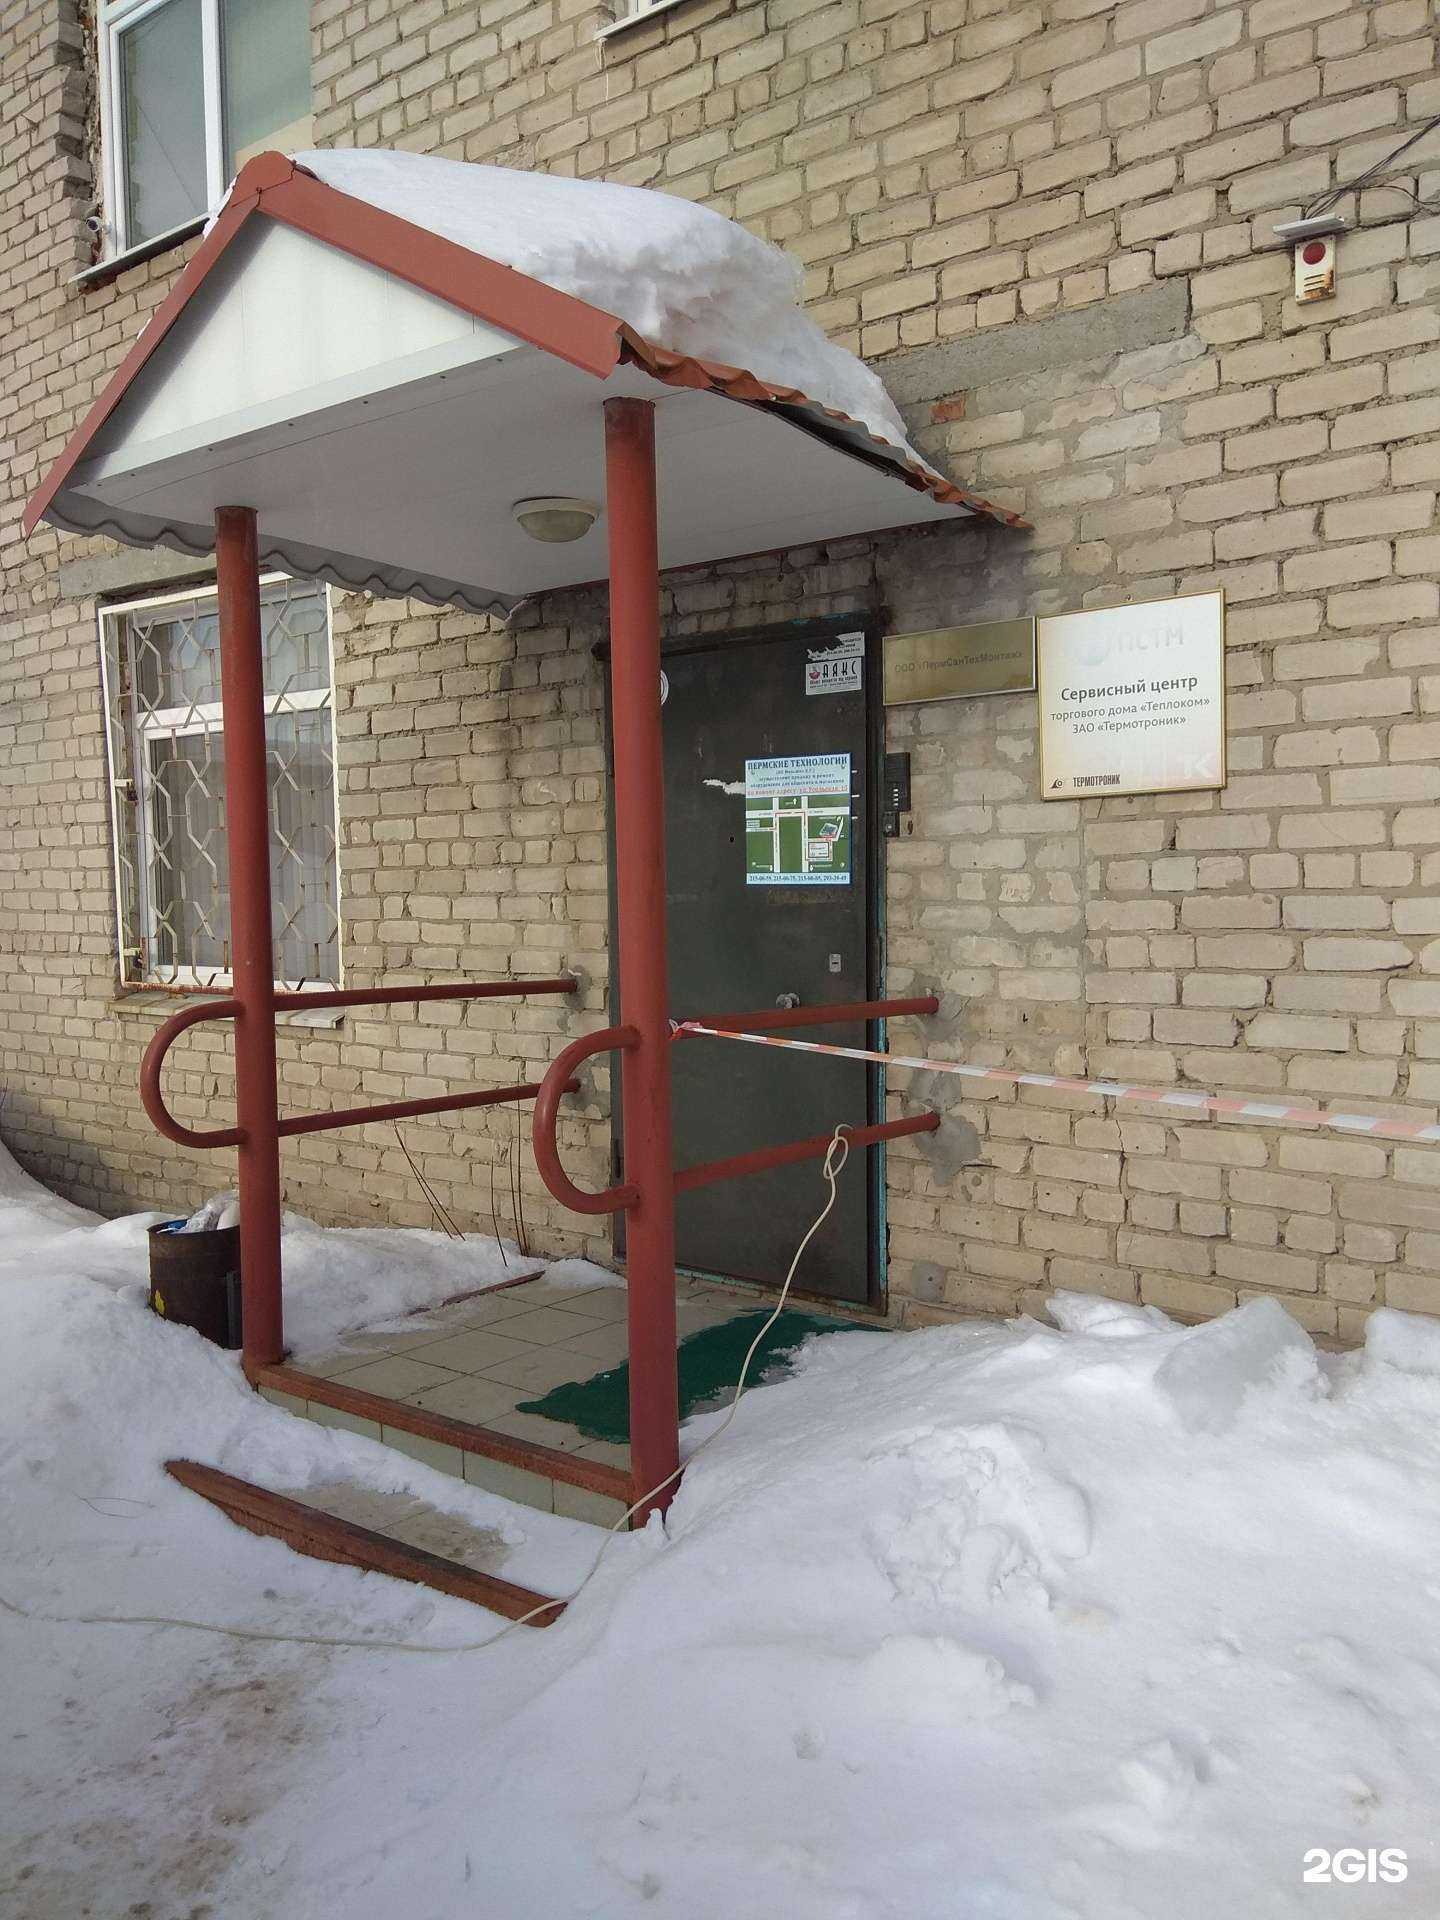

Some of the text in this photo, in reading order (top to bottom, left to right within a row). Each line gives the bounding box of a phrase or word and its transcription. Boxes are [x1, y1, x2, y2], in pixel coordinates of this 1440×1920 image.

[822, 660, 857, 678] АЯКС
[894, 662, 916, 673] ООО
[1061, 676, 1198, 703] Сервисный центр
[1050, 696, 1211, 723] торгового дома «Теплоком»
[1072, 716, 1187, 734] ЗАО «Термотроник»
[747, 756, 848, 770] ПЕРМСКИЕ ТЕХНОЛОГИИ
[1072, 773, 1121, 788] ТЕРМОТРОНИК
